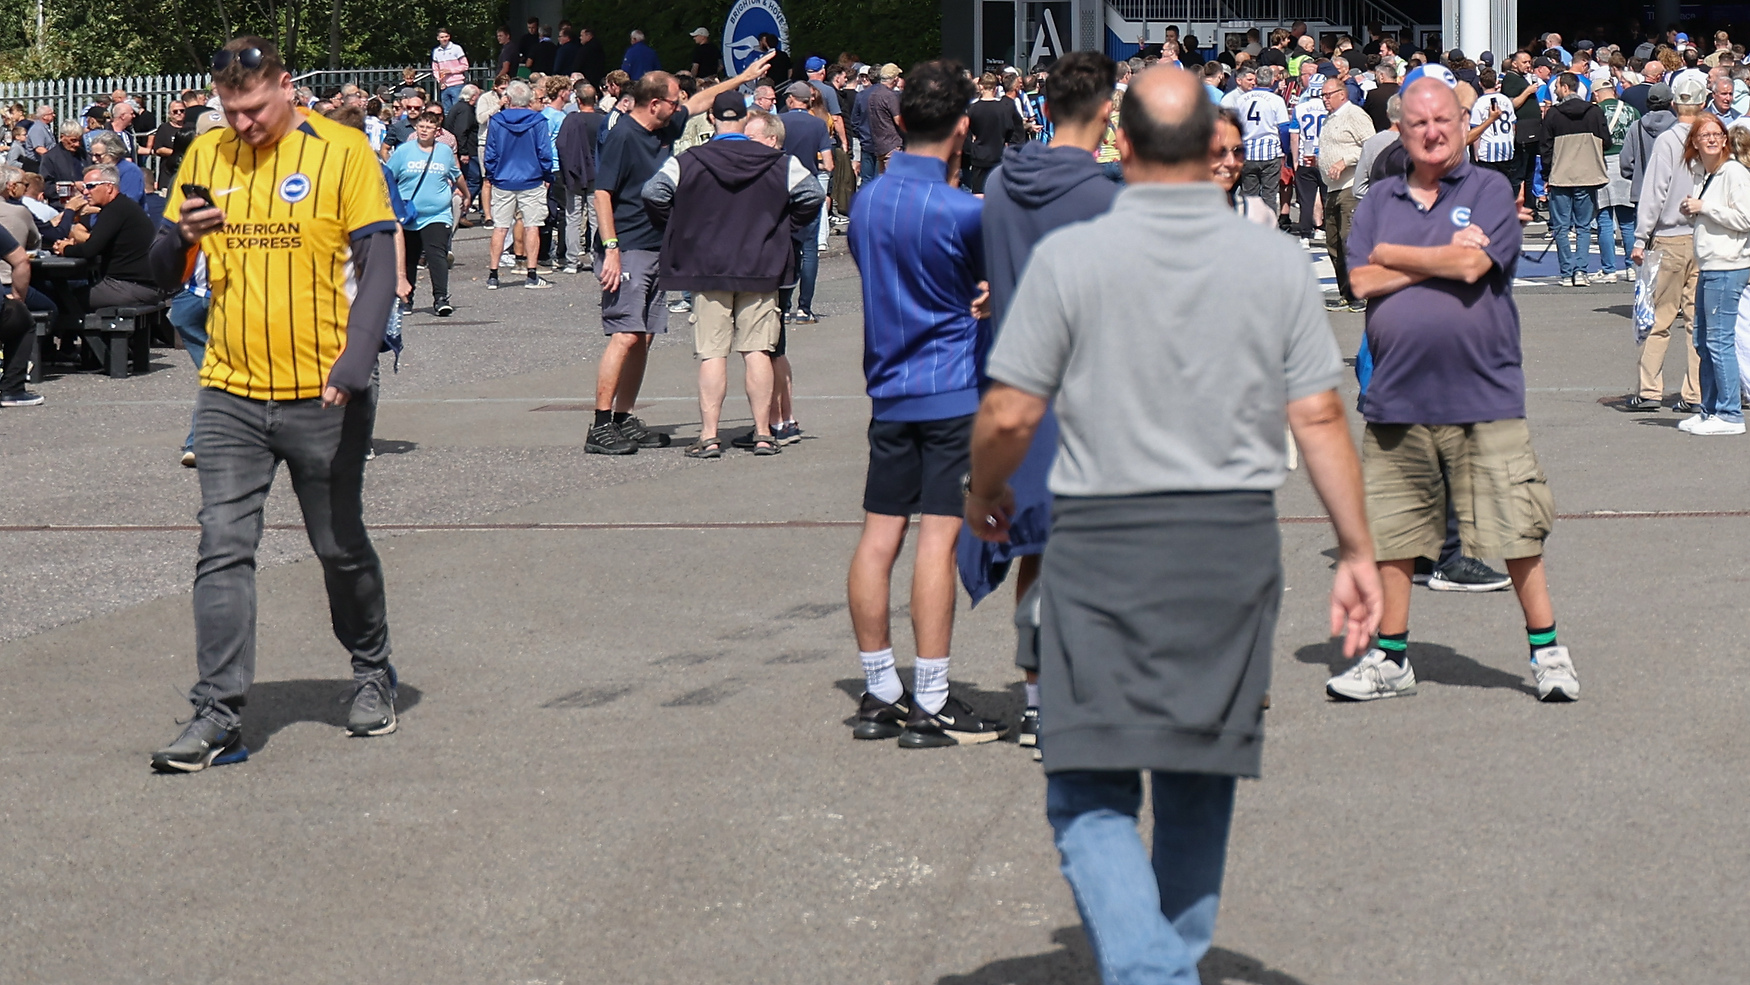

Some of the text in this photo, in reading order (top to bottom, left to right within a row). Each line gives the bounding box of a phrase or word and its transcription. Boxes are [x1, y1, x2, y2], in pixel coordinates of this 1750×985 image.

[768, 3, 785, 24] HOVE
[1247, 100, 1261, 126] 4
[216, 222, 300, 235] AMERICAN
[226, 236, 302, 249] EXPRESS
